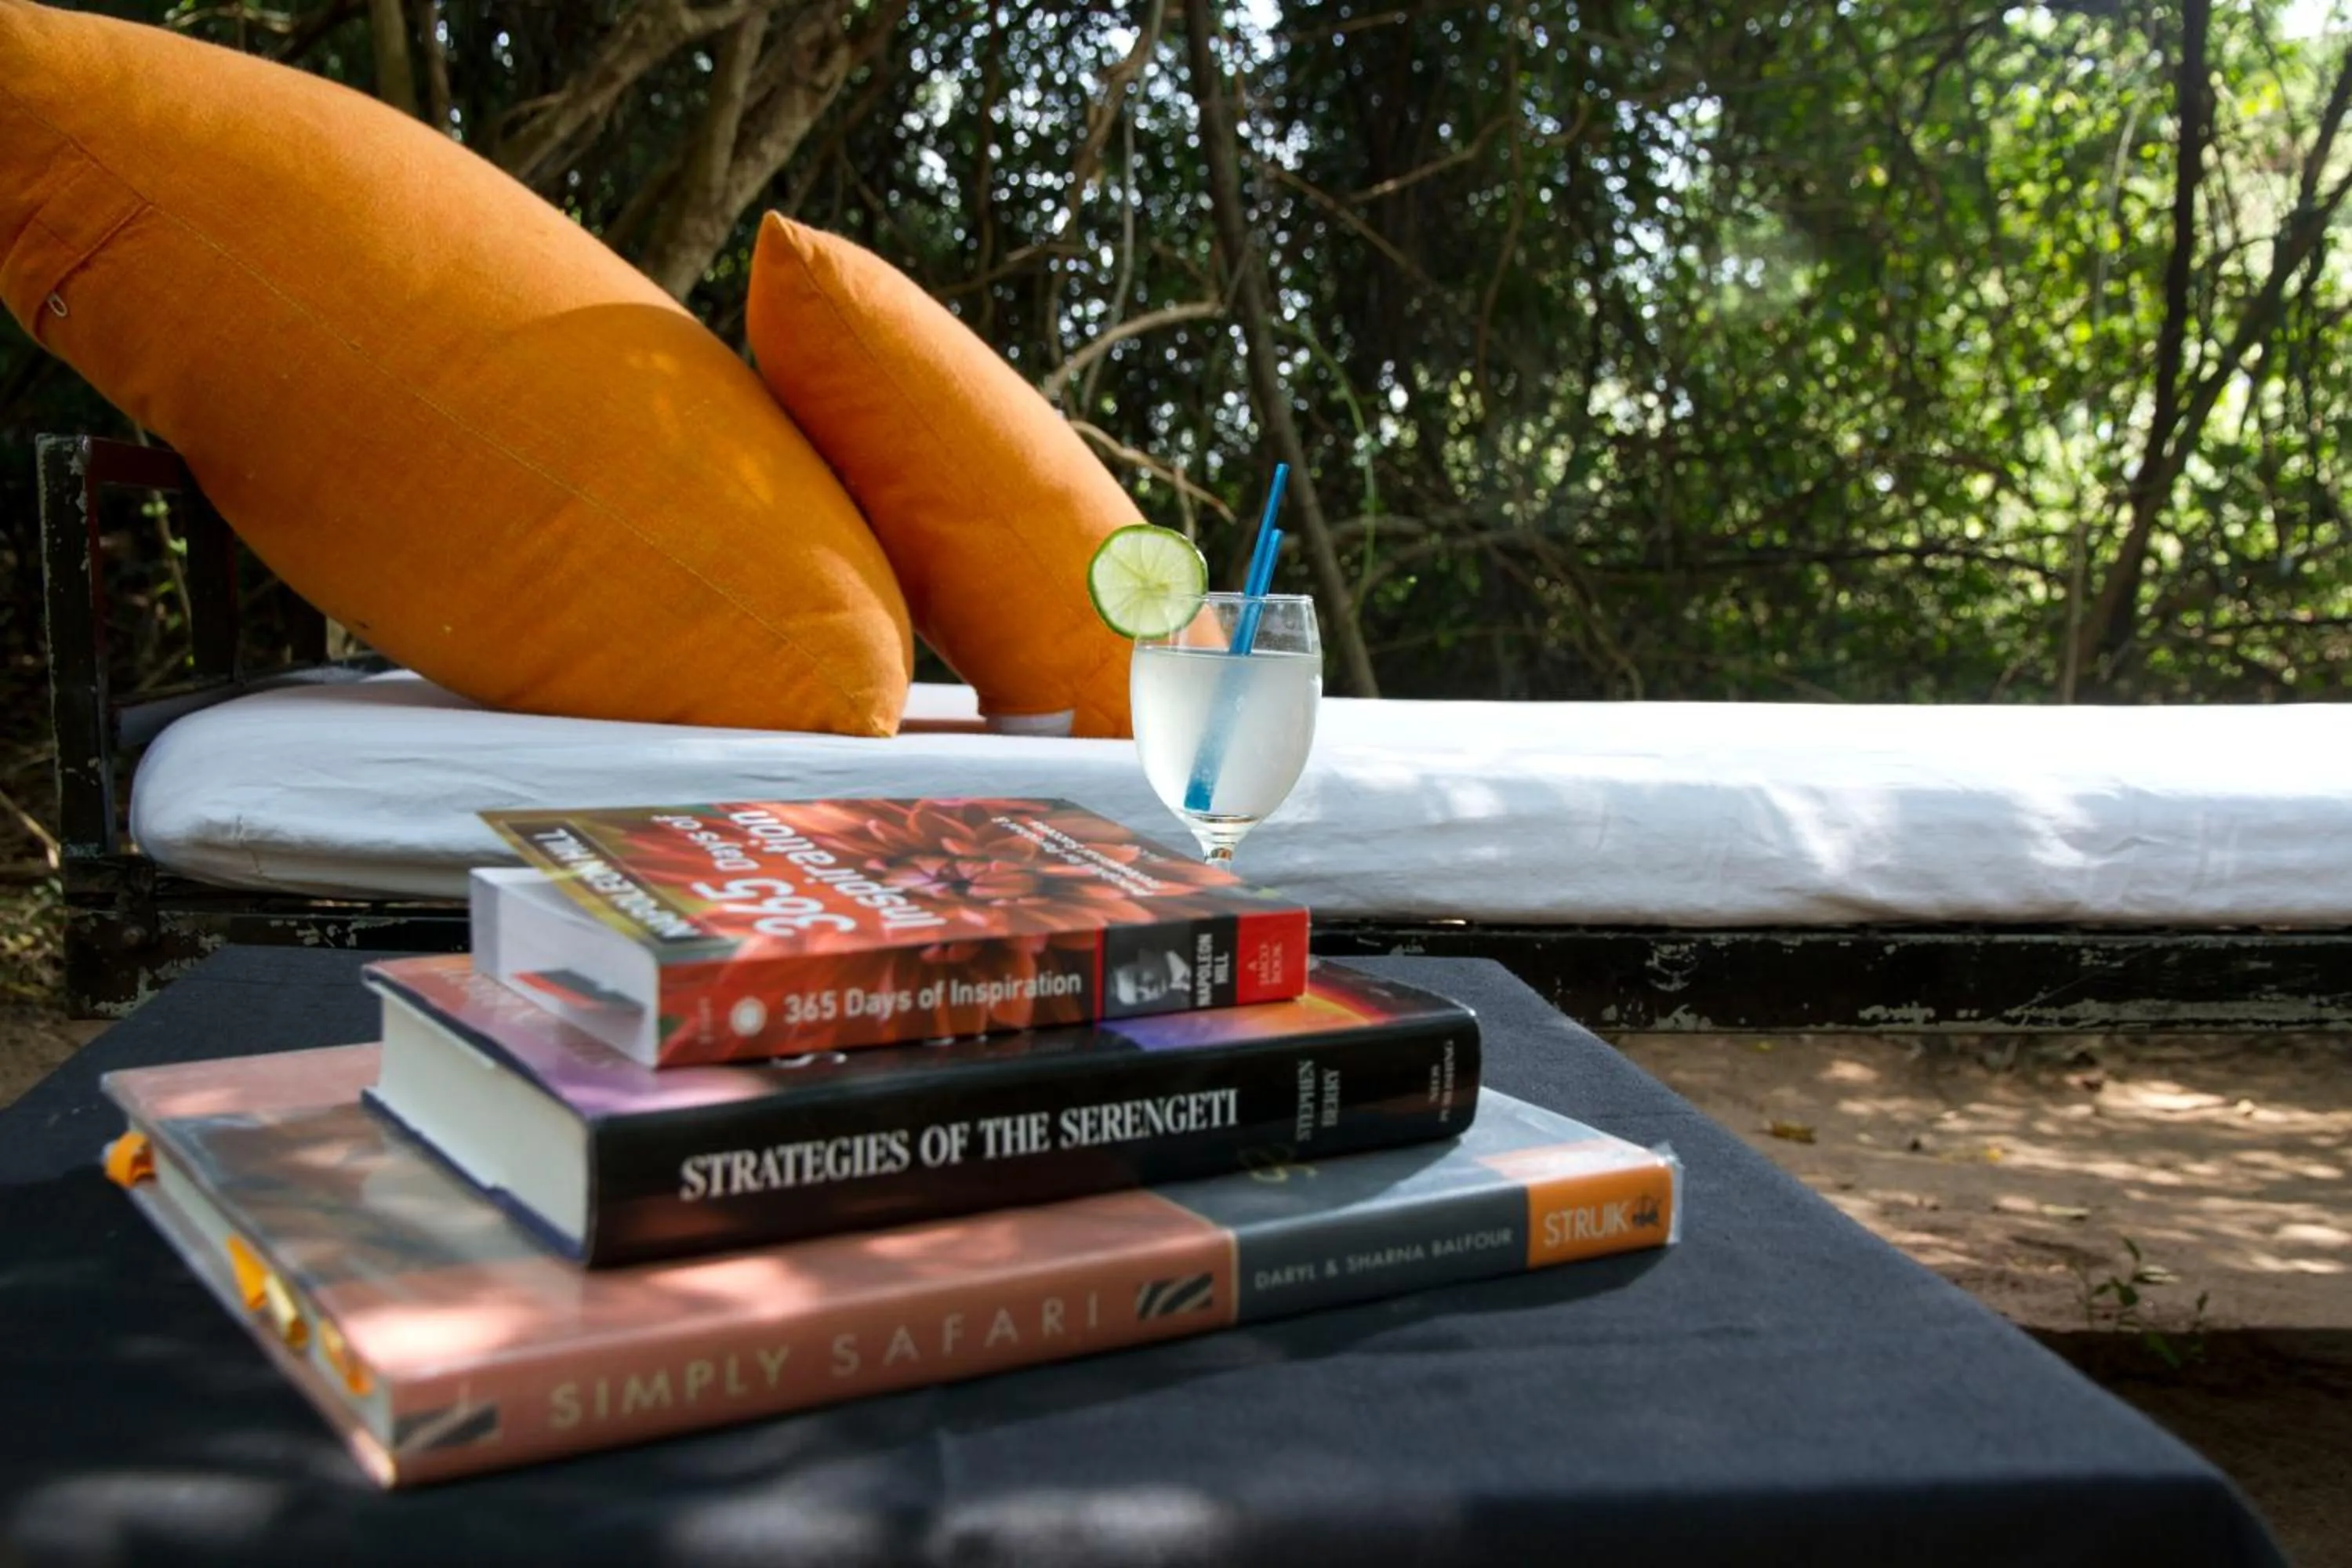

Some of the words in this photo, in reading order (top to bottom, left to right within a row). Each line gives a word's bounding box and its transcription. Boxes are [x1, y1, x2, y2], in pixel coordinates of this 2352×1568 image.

[534, 828, 597, 861] HILL
[650, 815, 703, 830] of
[688, 831, 760, 871] Days
[569, 860, 702, 938] NAPOLEON
[728, 811, 947, 928] Inspiration
[691, 877, 857, 937] 365
[784, 990, 837, 1024] 365
[845, 988, 912, 1021] Days
[918, 980, 946, 1009] of
[950, 972, 1082, 1009] Inspiration
[1197, 933, 1213, 1007] NAPOLEON
[1214, 952, 1229, 985] HILL
[1297, 1060, 1315, 1142] STEPHEN
[1321, 1068, 1340, 1127] BERRY
[679, 1129, 910, 1202] STRATEGIES
[920, 1123, 970, 1167] OF
[979, 1112, 1049, 1159] THE
[1059, 1088, 1239, 1149] SERENGETI
[1543, 1200, 1631, 1248] STRUIK
[1254, 1262, 1316, 1290] DARYL
[1323, 1258, 1339, 1277] &
[1346, 1243, 1425, 1273] SHARNA
[1431, 1227, 1514, 1258] BALFOUR
[550, 1345, 790, 1429] SIMPLY
[831, 1290, 1099, 1377] SAFARI
